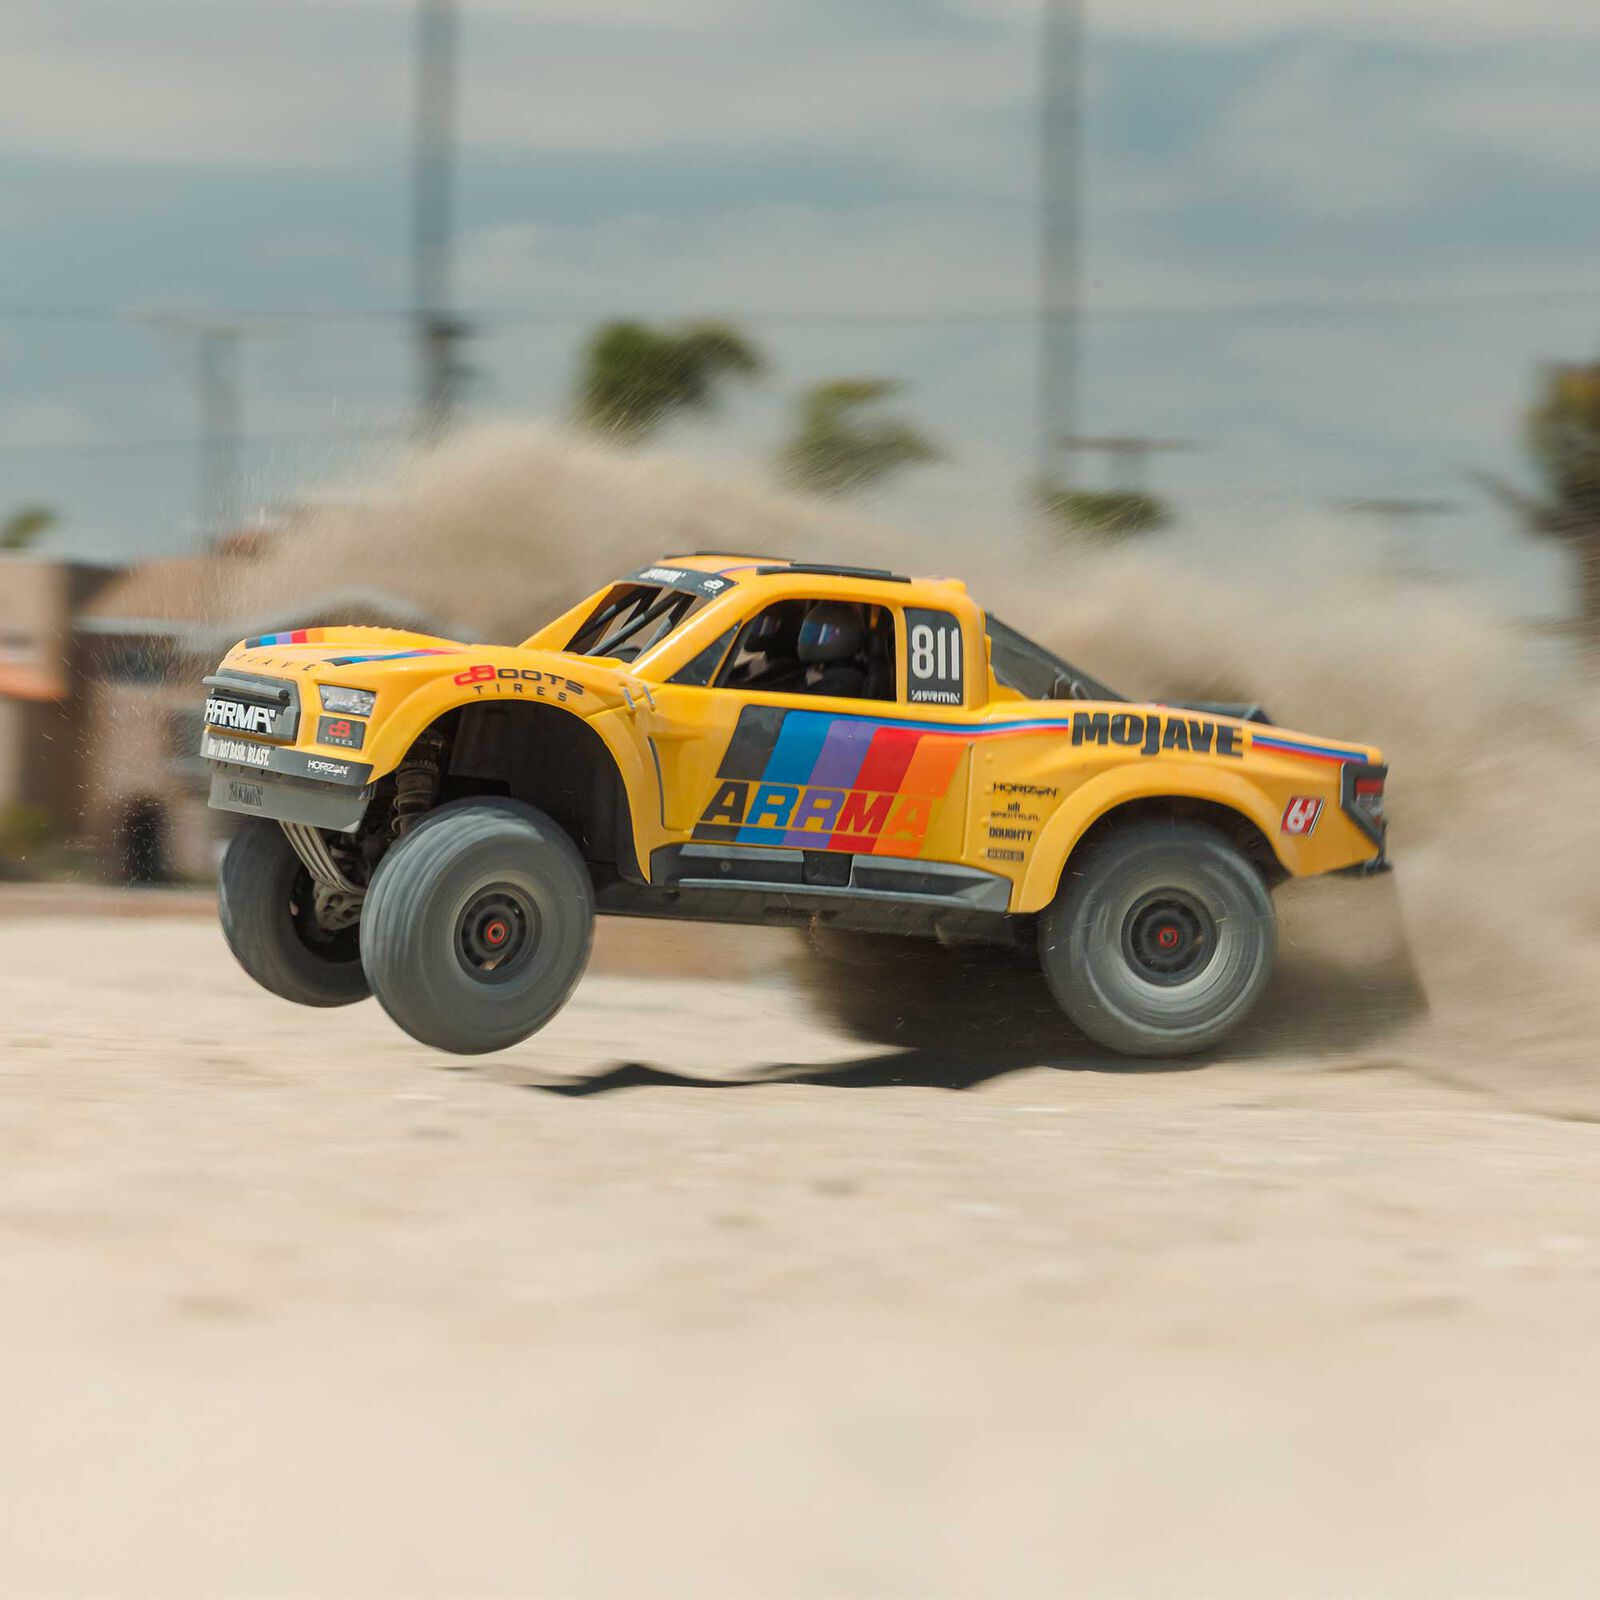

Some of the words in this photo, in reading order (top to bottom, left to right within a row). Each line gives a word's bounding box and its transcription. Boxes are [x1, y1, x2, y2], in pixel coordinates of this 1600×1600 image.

[911, 624, 960, 681] 811
[230, 653, 316, 672] JAVE
[474, 683, 568, 702] TIRES
[325, 736, 353, 746] TIRES
[1071, 711, 1244, 759] MOJAVE
[700, 780, 933, 839] ARRMA
[988, 826, 1033, 843] DOUGHTY
